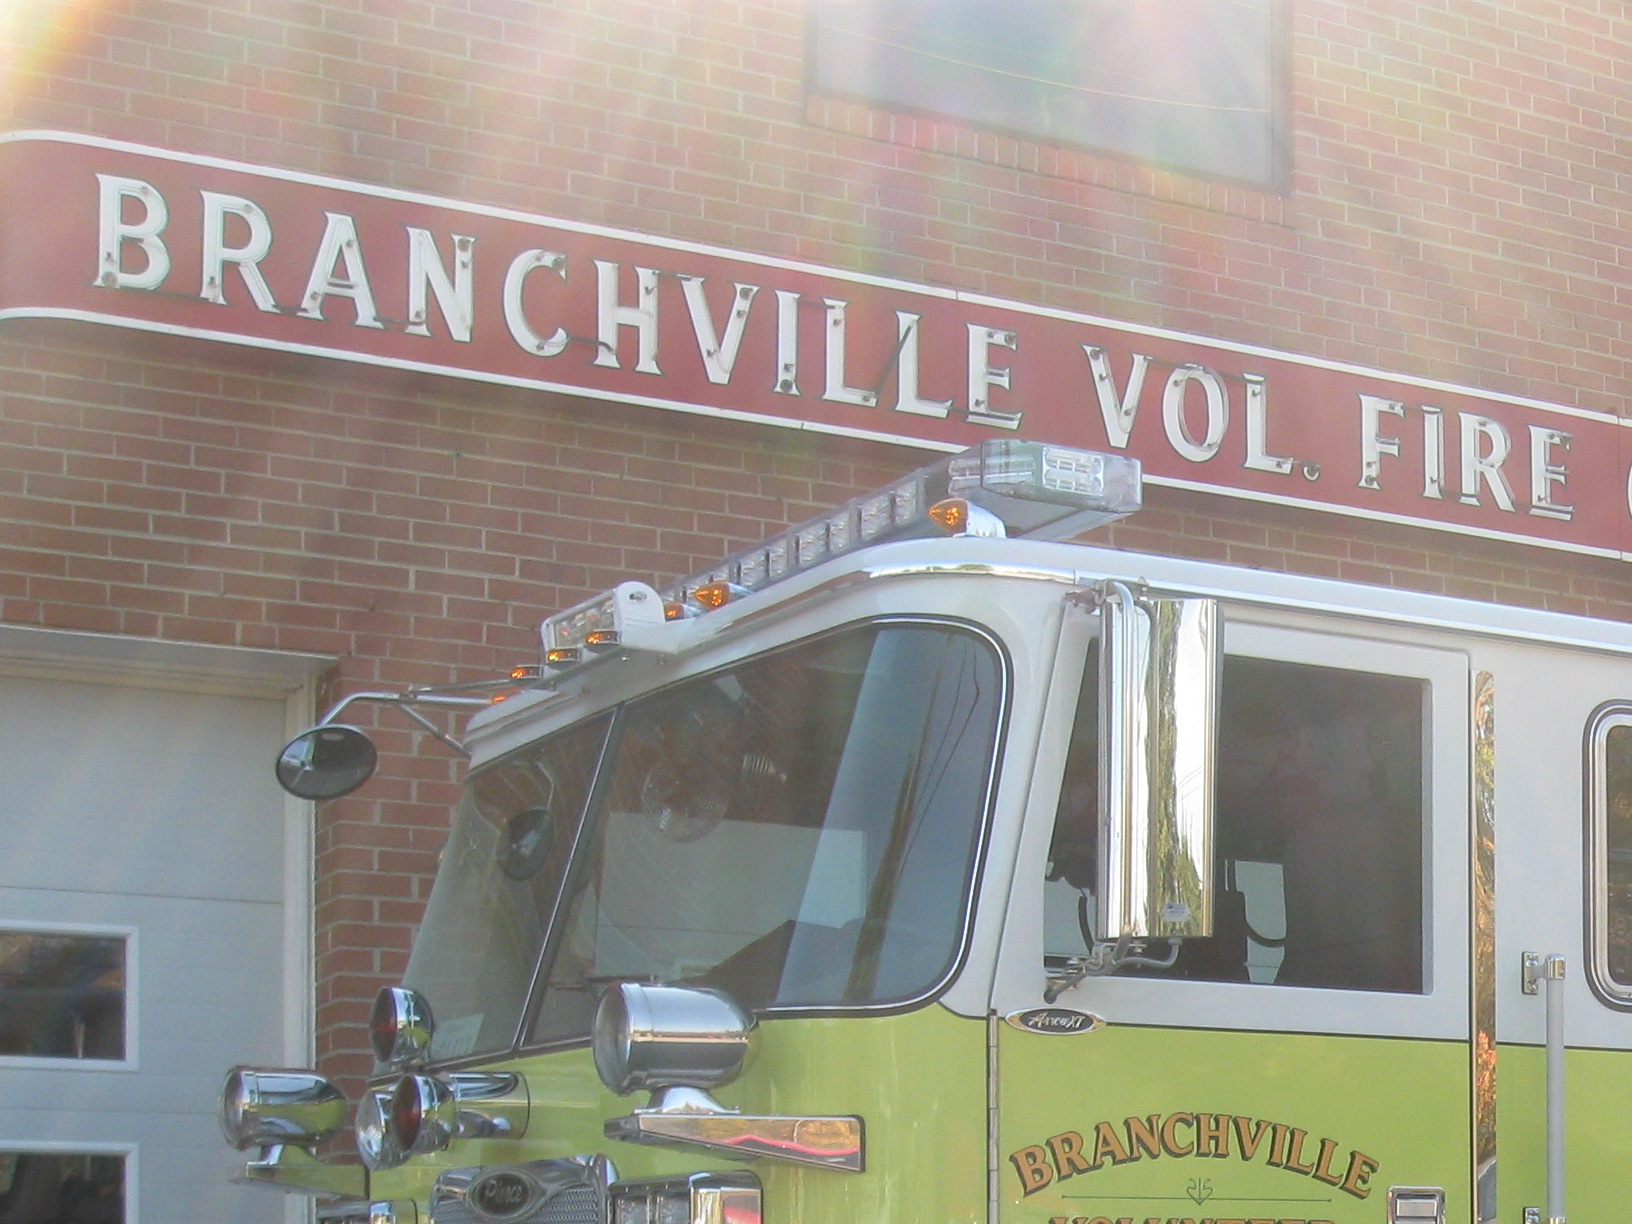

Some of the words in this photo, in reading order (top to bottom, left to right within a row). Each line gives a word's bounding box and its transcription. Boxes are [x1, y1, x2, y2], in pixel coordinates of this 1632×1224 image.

[94, 173, 1023, 430] BRANCHVILLE
[1081, 343, 1321, 481] VOL.
[1357, 393, 1576, 521] FIRE
[1009, 1111, 1380, 1199] BRANCHVILLE
